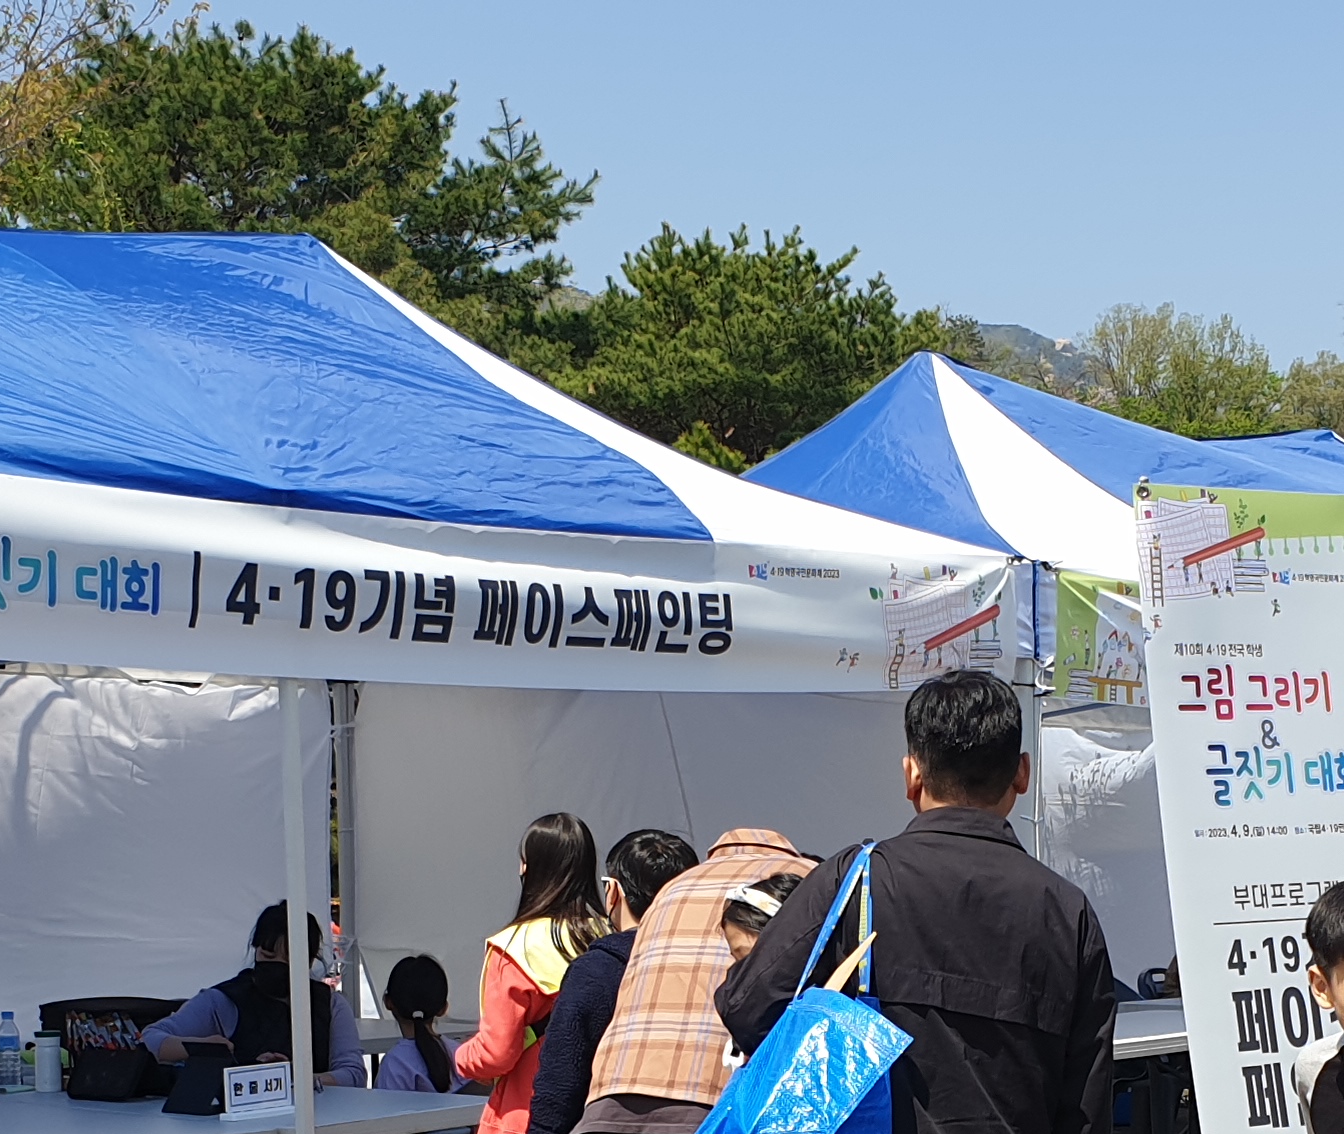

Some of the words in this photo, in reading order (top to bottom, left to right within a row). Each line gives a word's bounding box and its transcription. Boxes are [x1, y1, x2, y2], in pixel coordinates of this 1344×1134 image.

[75, 558, 161, 616] 대회
[225, 561, 457, 646] 4·19기념
[474, 575, 736, 657] 페이스페인팅
[1174, 643, 1204, 657] 제10회
[1228, 644, 1245, 657] 전국
[1246, 643, 1264, 657] 학생
[1178, 664, 1235, 720] 그림
[1246, 671, 1332, 713] 그리기
[1260, 719, 1280, 750] &
[1206, 744, 1295, 806] 글짓기
[1232, 986, 1341, 1053] 페이
[264, 1077, 282, 1092] 서기
